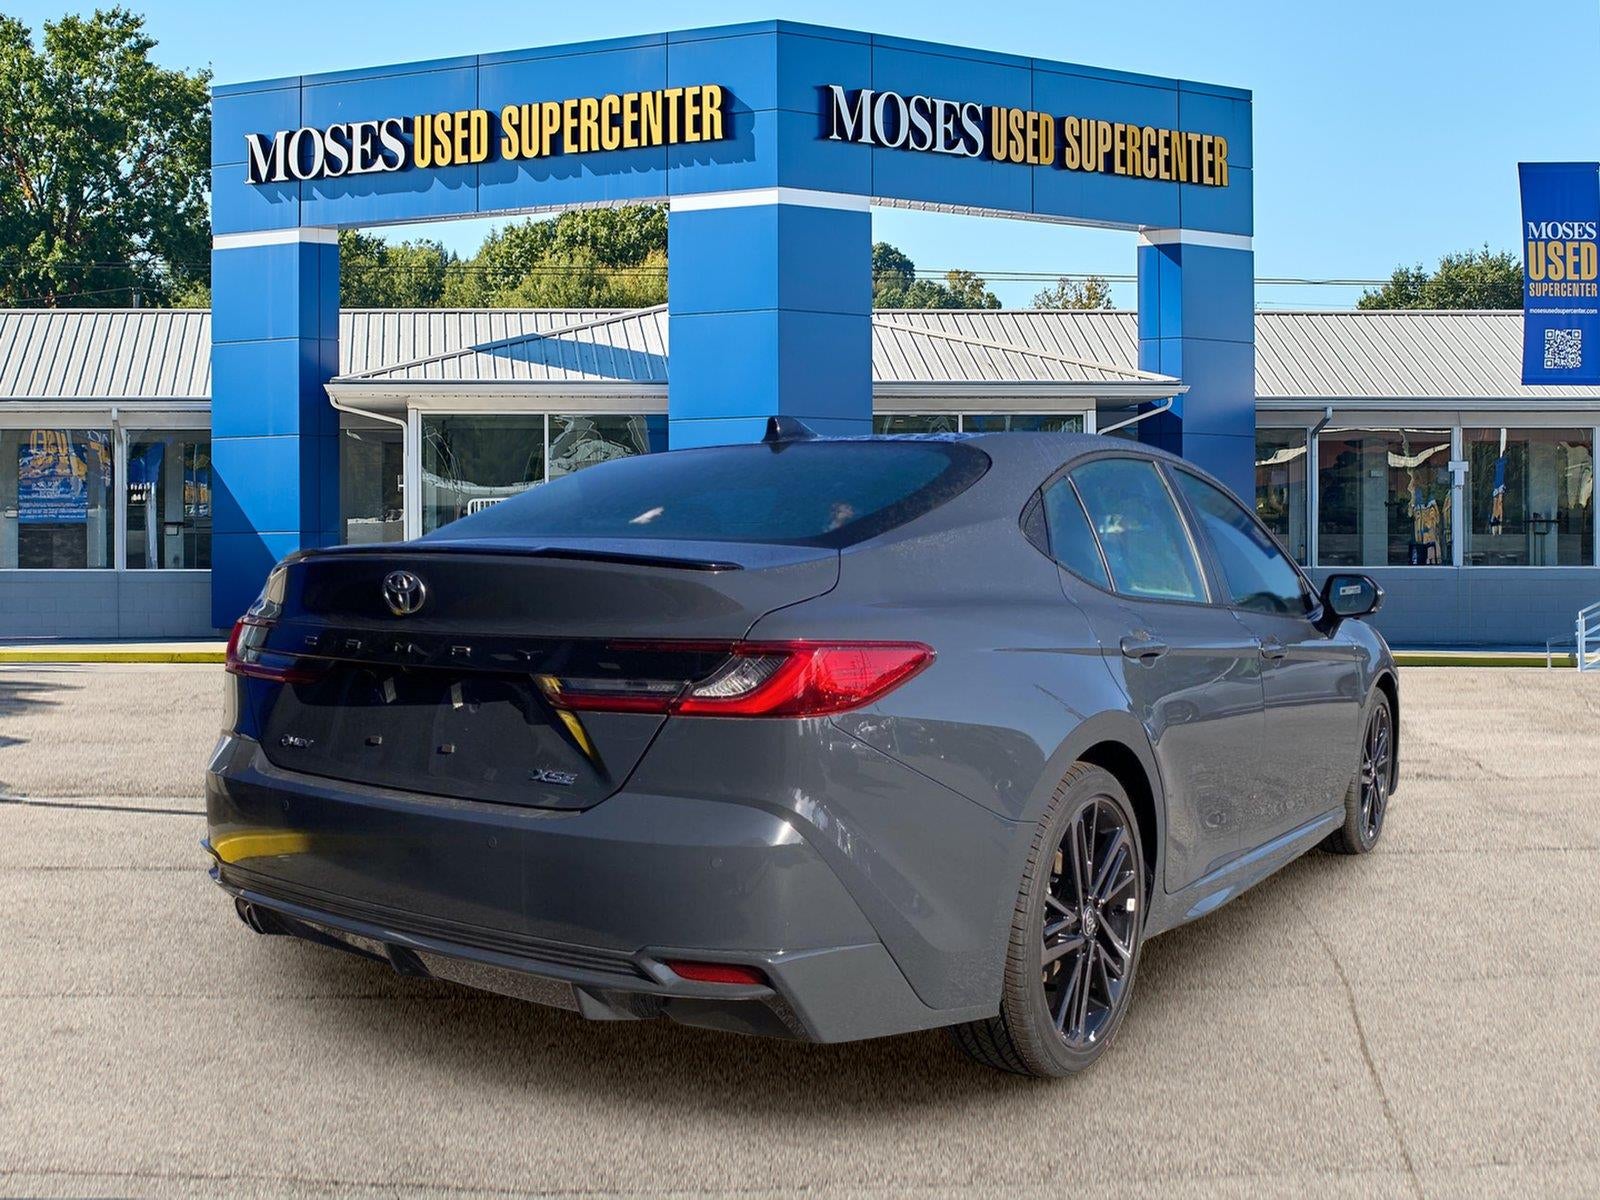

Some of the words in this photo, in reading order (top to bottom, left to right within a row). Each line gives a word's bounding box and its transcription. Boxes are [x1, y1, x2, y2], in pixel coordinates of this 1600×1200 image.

[244, 117, 406, 185] MOSES
[413, 108, 489, 169] USED
[500, 84, 725, 161] SUPERCENTER
[828, 84, 985, 158] MOSES
[990, 106, 1056, 167] USED
[1064, 116, 1230, 187] SUPERCENTER
[1527, 221, 1597, 240] MOSES
[1528, 241, 1598, 281] USED
[1529, 282, 1598, 297] SUPERCENTER
